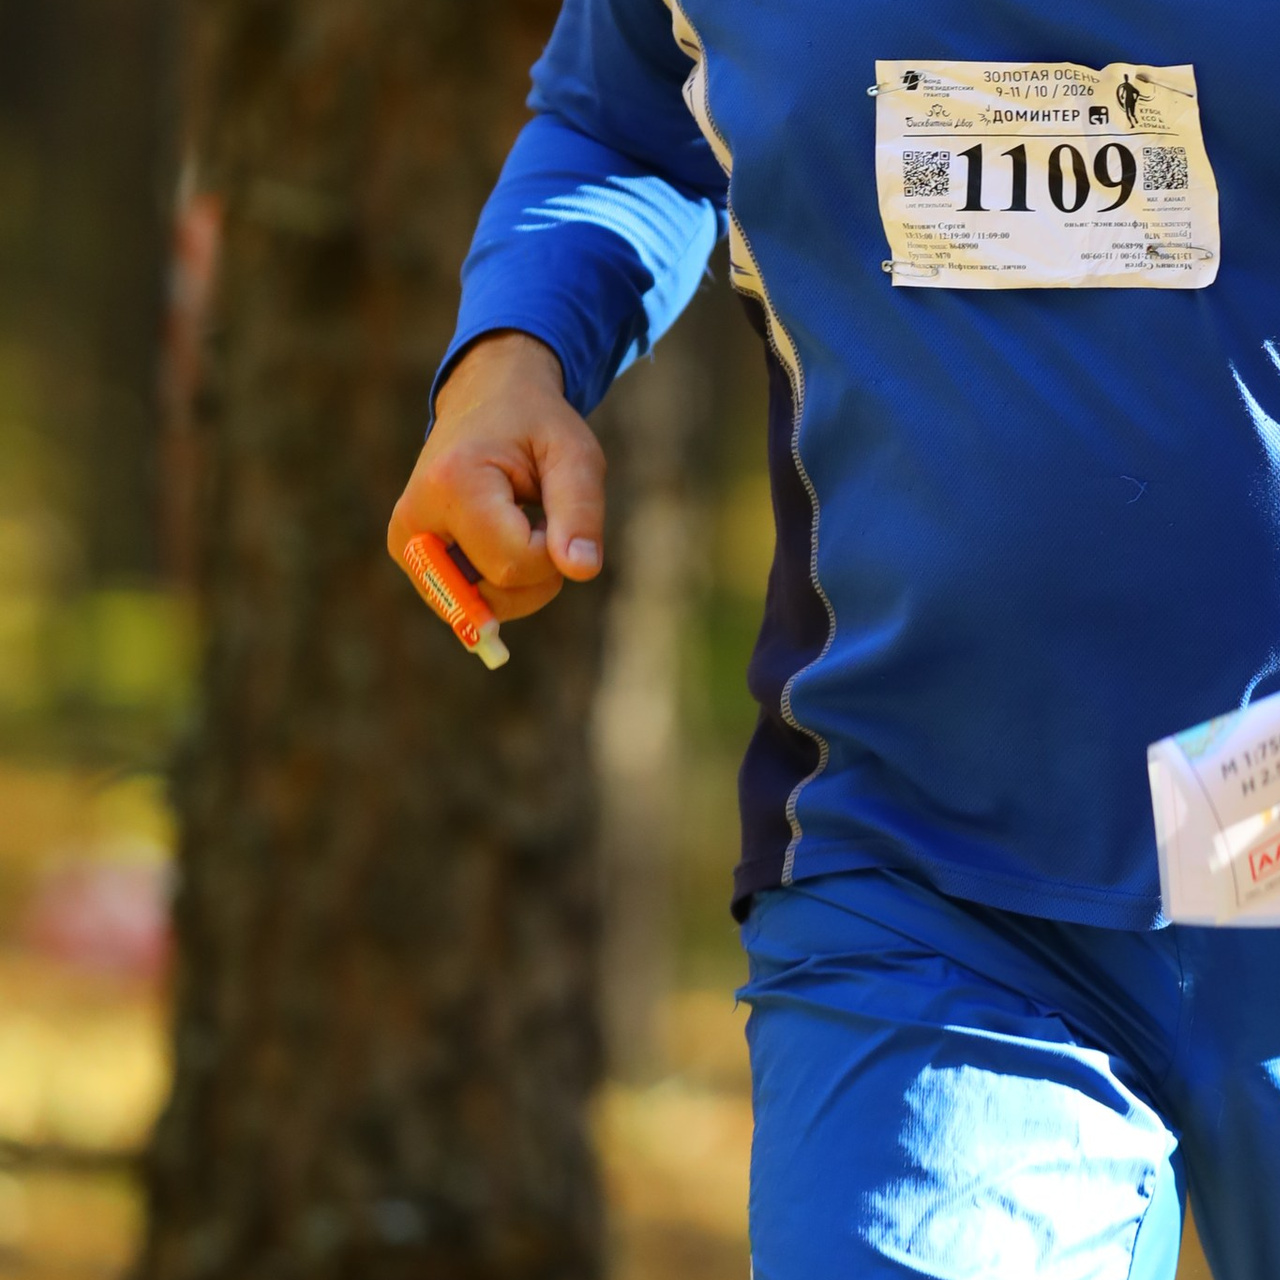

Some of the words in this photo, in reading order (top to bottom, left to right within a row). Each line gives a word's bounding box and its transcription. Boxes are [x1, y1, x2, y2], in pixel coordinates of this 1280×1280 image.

[984, 70, 1049, 82] ЗОЛОТАЯ
[1054, 69, 1100, 84] ОСЕНЬ
[996, 86, 1020, 98] 9-11
[1035, 86, 1048, 97] 10
[1063, 84, 1094, 96] 2026
[993, 109, 1081, 124] ДОМИНТЕР
[956, 142, 1137, 213] 1109
